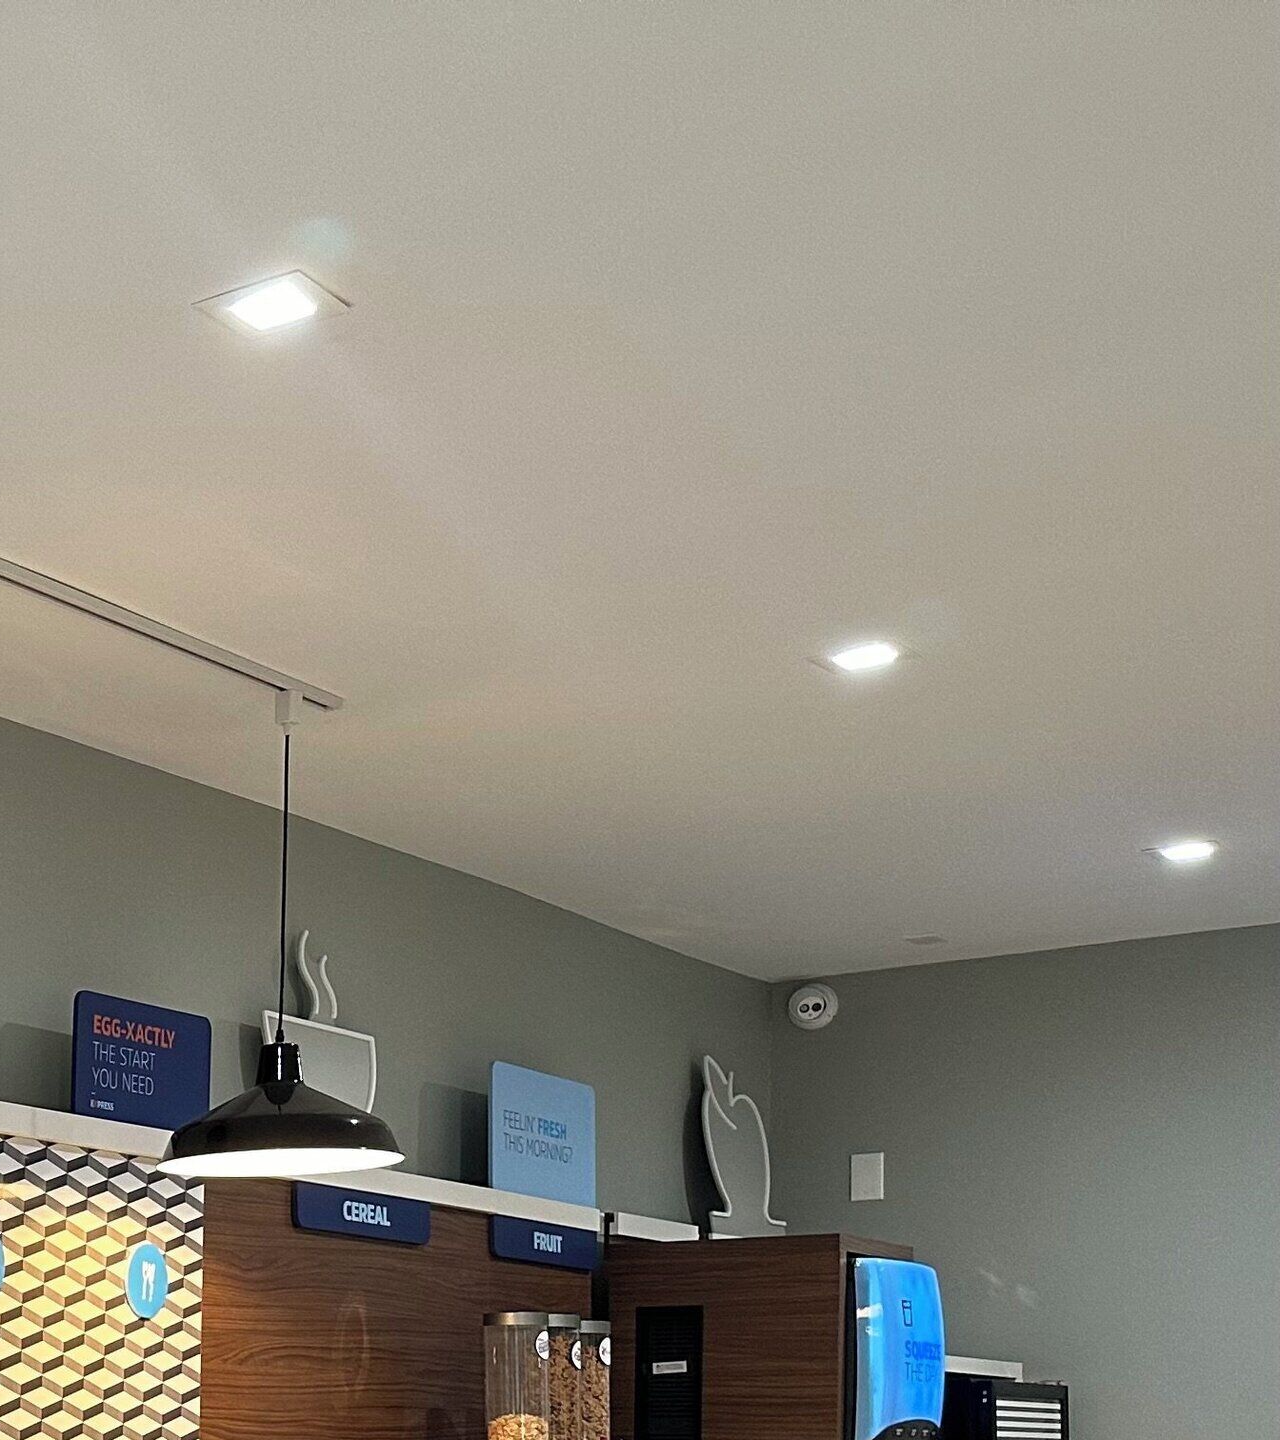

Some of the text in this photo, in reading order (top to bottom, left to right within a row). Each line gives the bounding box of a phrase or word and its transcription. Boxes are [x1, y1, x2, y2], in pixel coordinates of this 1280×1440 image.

[93, 1014, 175, 1048] EGG-XACTLY
[92, 1041, 155, 1071] THE START
[92, 1066, 154, 1096] YOU NEED
[537, 1117, 567, 1140] FRESH
[503, 1132, 524, 1154] THIS
[342, 1200, 391, 1227] CEREAL
[533, 1231, 563, 1254] FRUIT
[904, 1361, 923, 1384] THE
